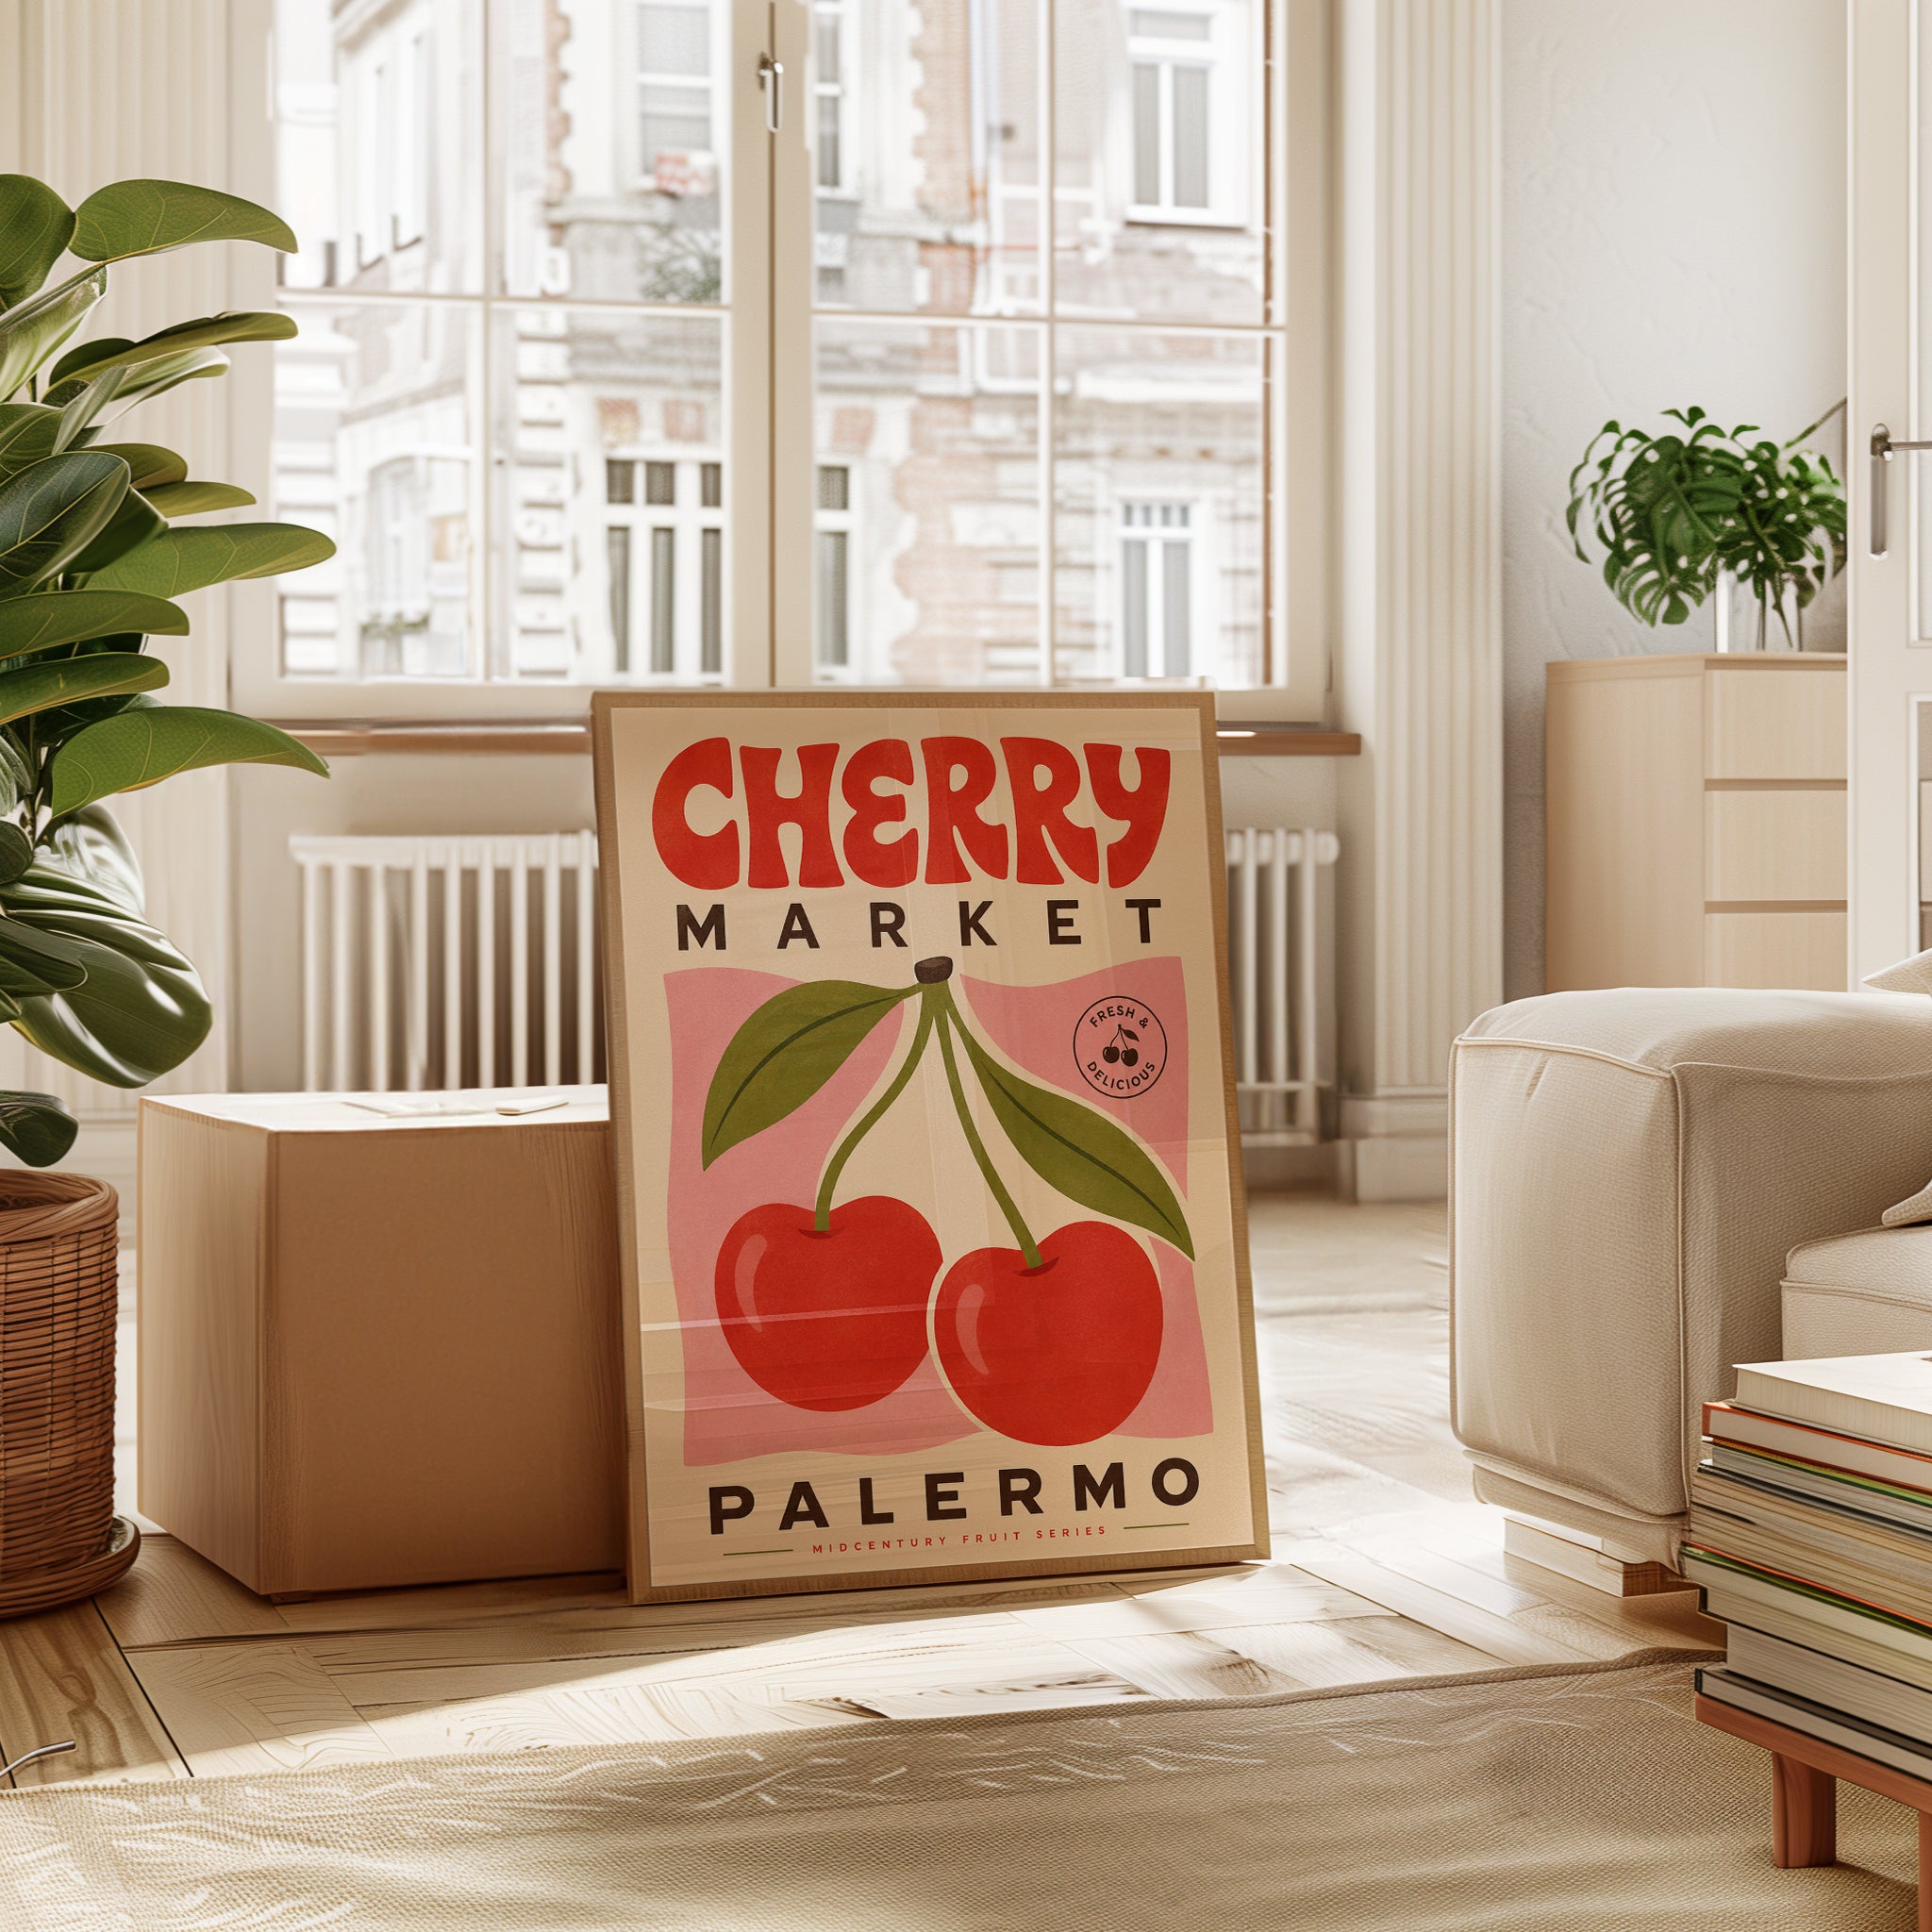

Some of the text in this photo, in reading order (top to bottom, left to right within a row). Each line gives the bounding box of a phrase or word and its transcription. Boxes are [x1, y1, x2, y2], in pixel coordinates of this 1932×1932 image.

[652, 736, 1171, 890] CHERRY
[676, 898, 1161, 950] MARKET
[1090, 1005, 1149, 1028] FRESH &
[1087, 1061, 1155, 1090] DELICIOUS
[708, 1457, 1200, 1535] PALERMO
[812, 1525, 1107, 1554] MIDCENTURY FRUIT SERIES
